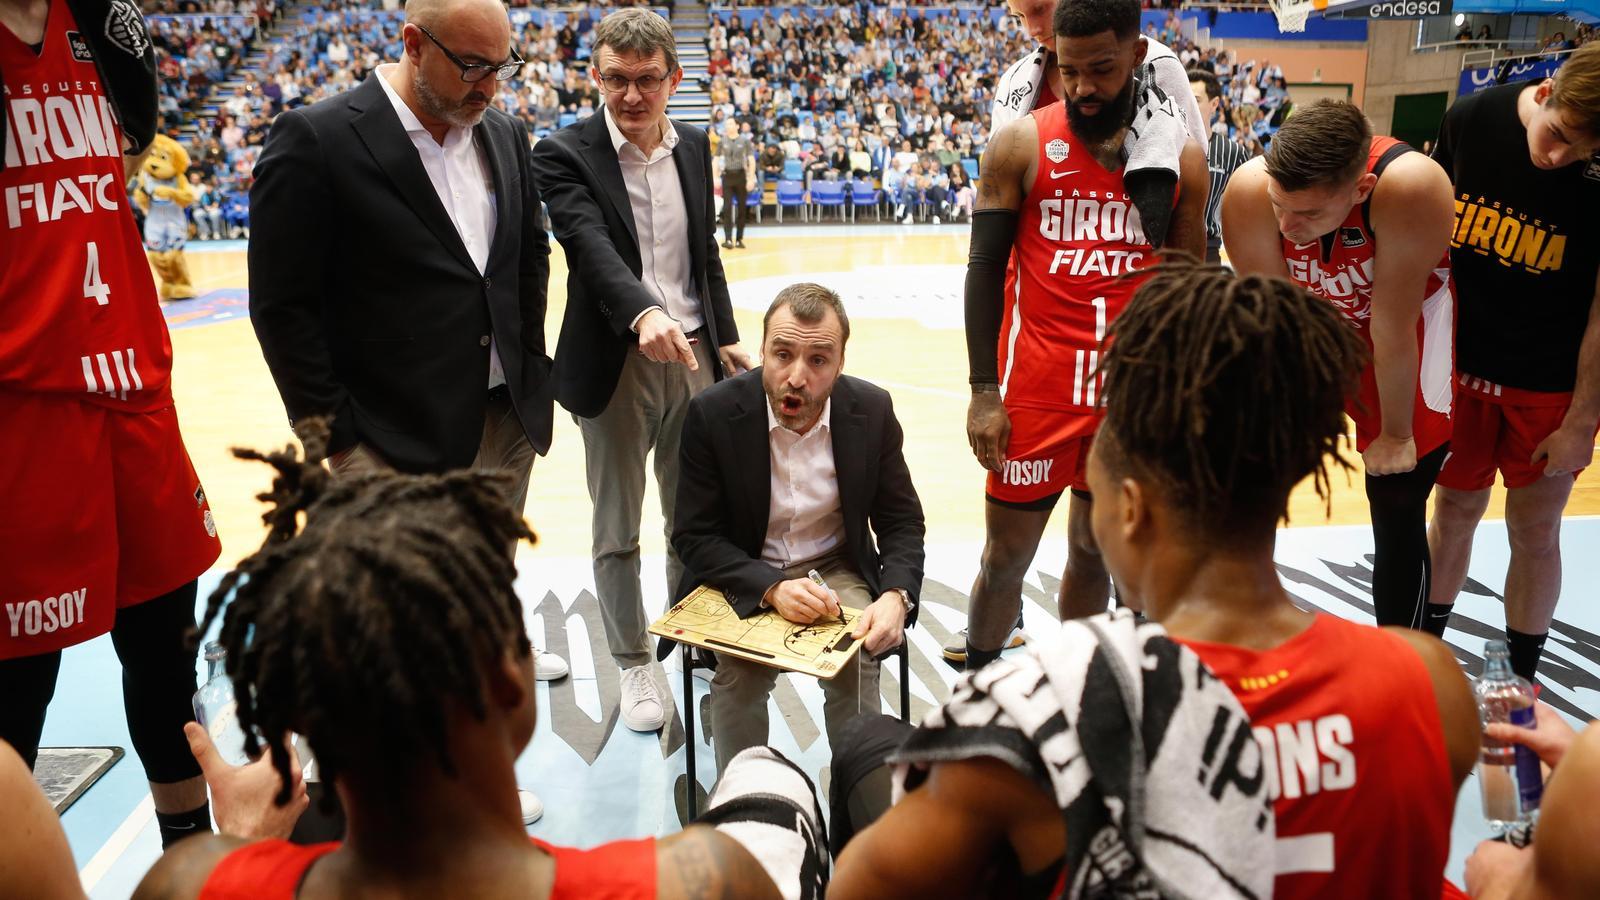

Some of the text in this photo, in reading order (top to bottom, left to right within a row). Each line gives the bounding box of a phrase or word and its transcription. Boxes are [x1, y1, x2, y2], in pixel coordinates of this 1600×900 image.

[1370, 0, 1441, 18] endesa
[4, 81, 97, 95] ASQUET
[5, 173, 119, 229] FIATC
[1055, 188, 1130, 200] BÀSQU
[1461, 193, 1558, 232] BÀSQUET
[1039, 199, 1150, 246] GIRON
[83, 241, 111, 305] 4
[1048, 249, 1145, 277] FIATC
[1091, 296, 1106, 342] 1
[1002, 458, 1054, 486] YOSOY
[6, 587, 87, 638] YOSOY
